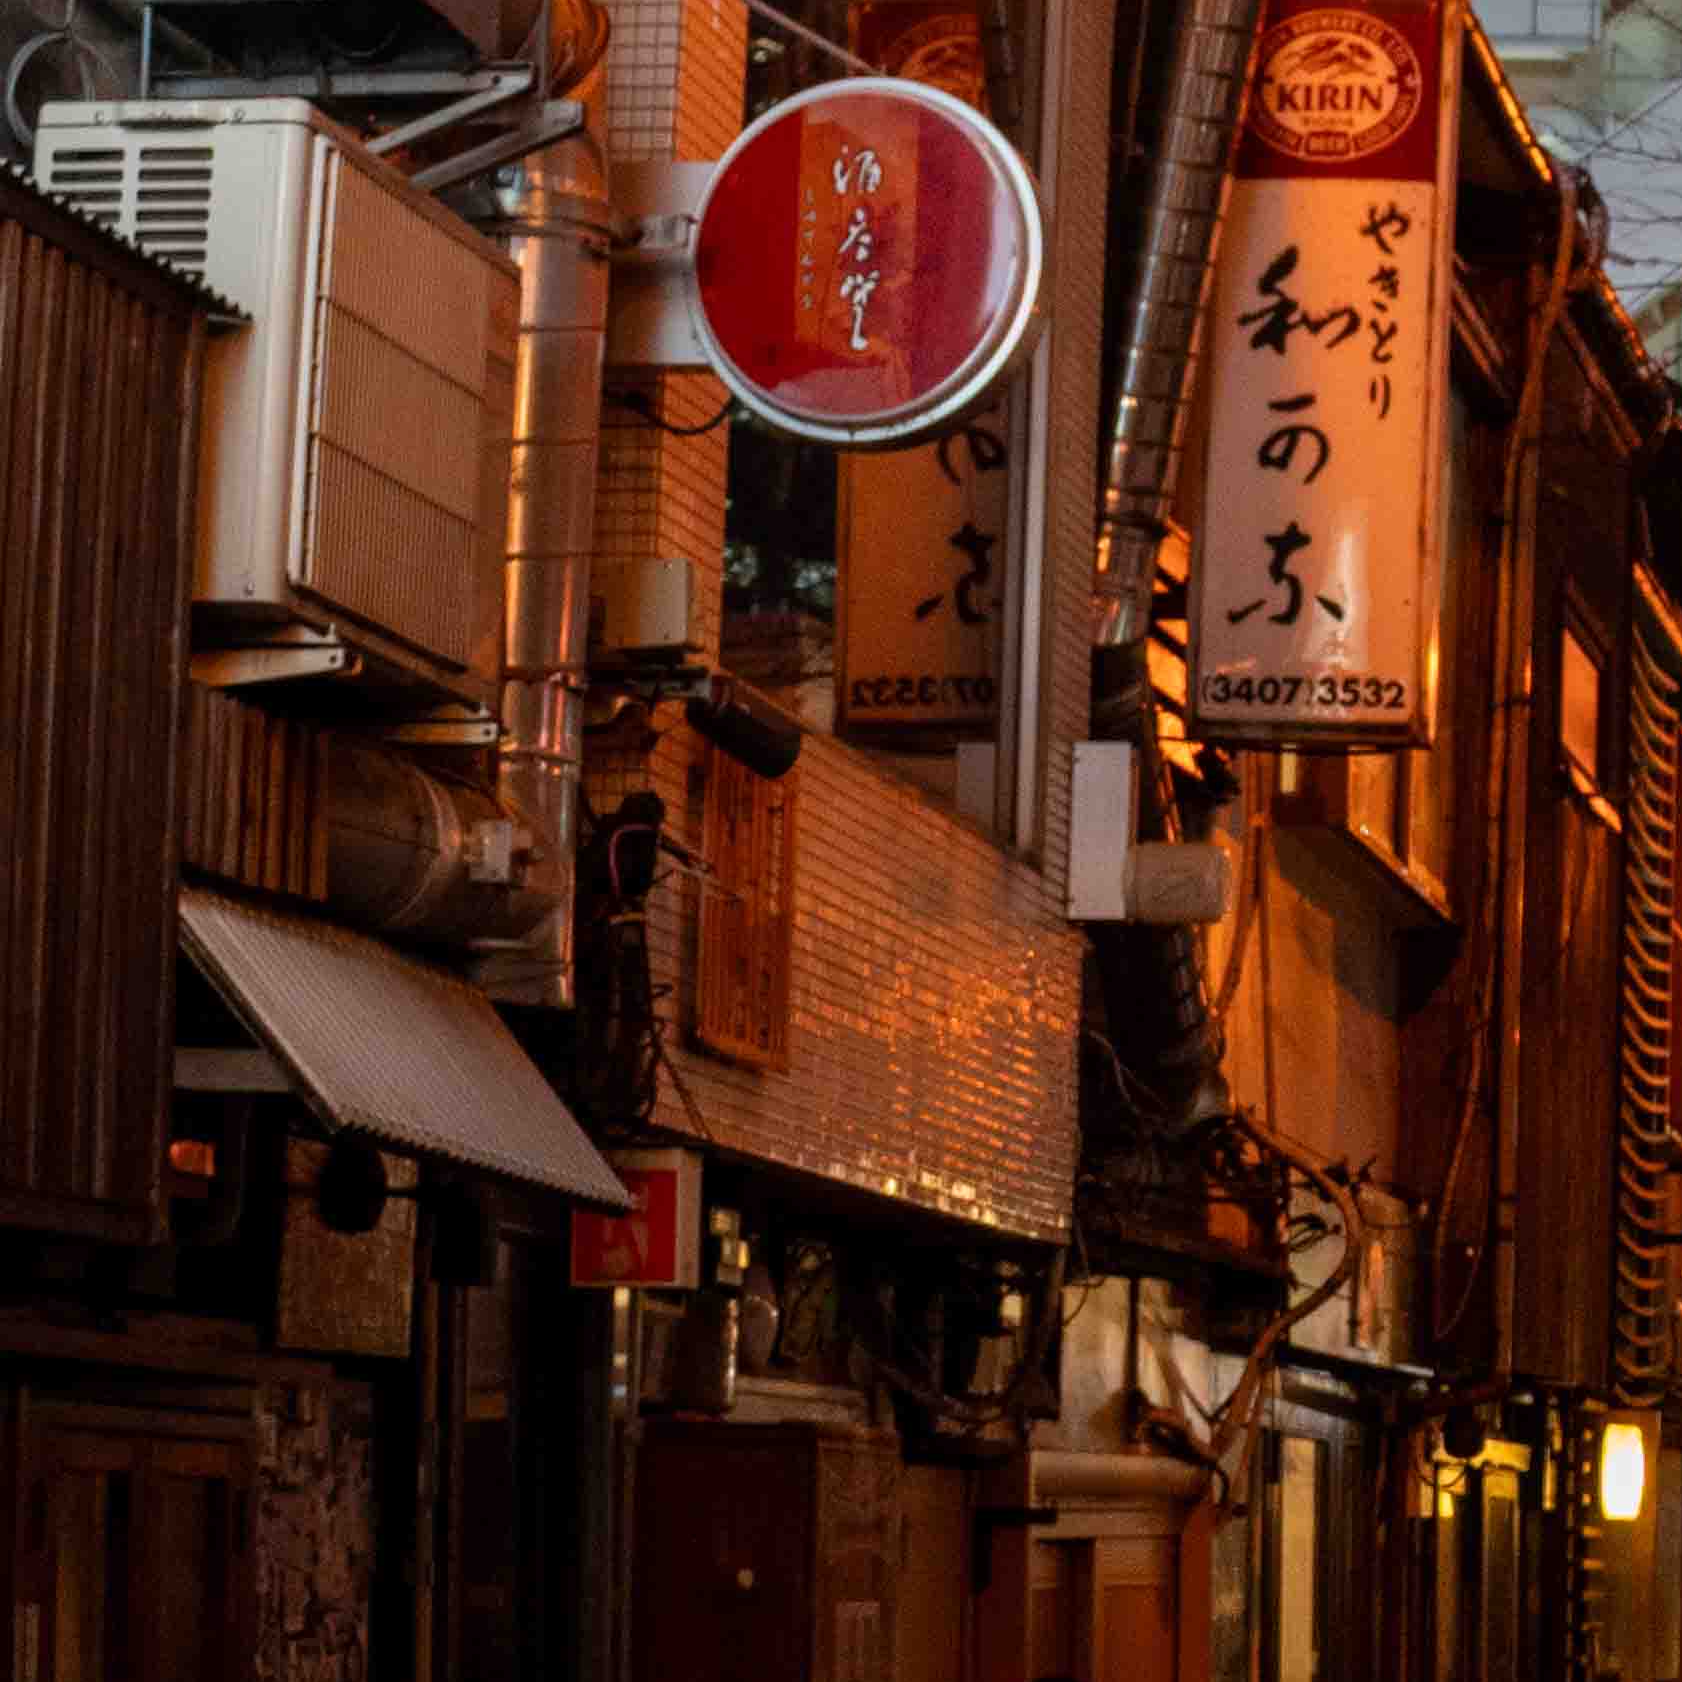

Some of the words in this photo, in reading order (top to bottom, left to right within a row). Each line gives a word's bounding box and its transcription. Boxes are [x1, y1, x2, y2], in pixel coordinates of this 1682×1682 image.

[1276, 84, 1383, 112] KIRIN
[1360, 201, 1412, 420] やきとり
